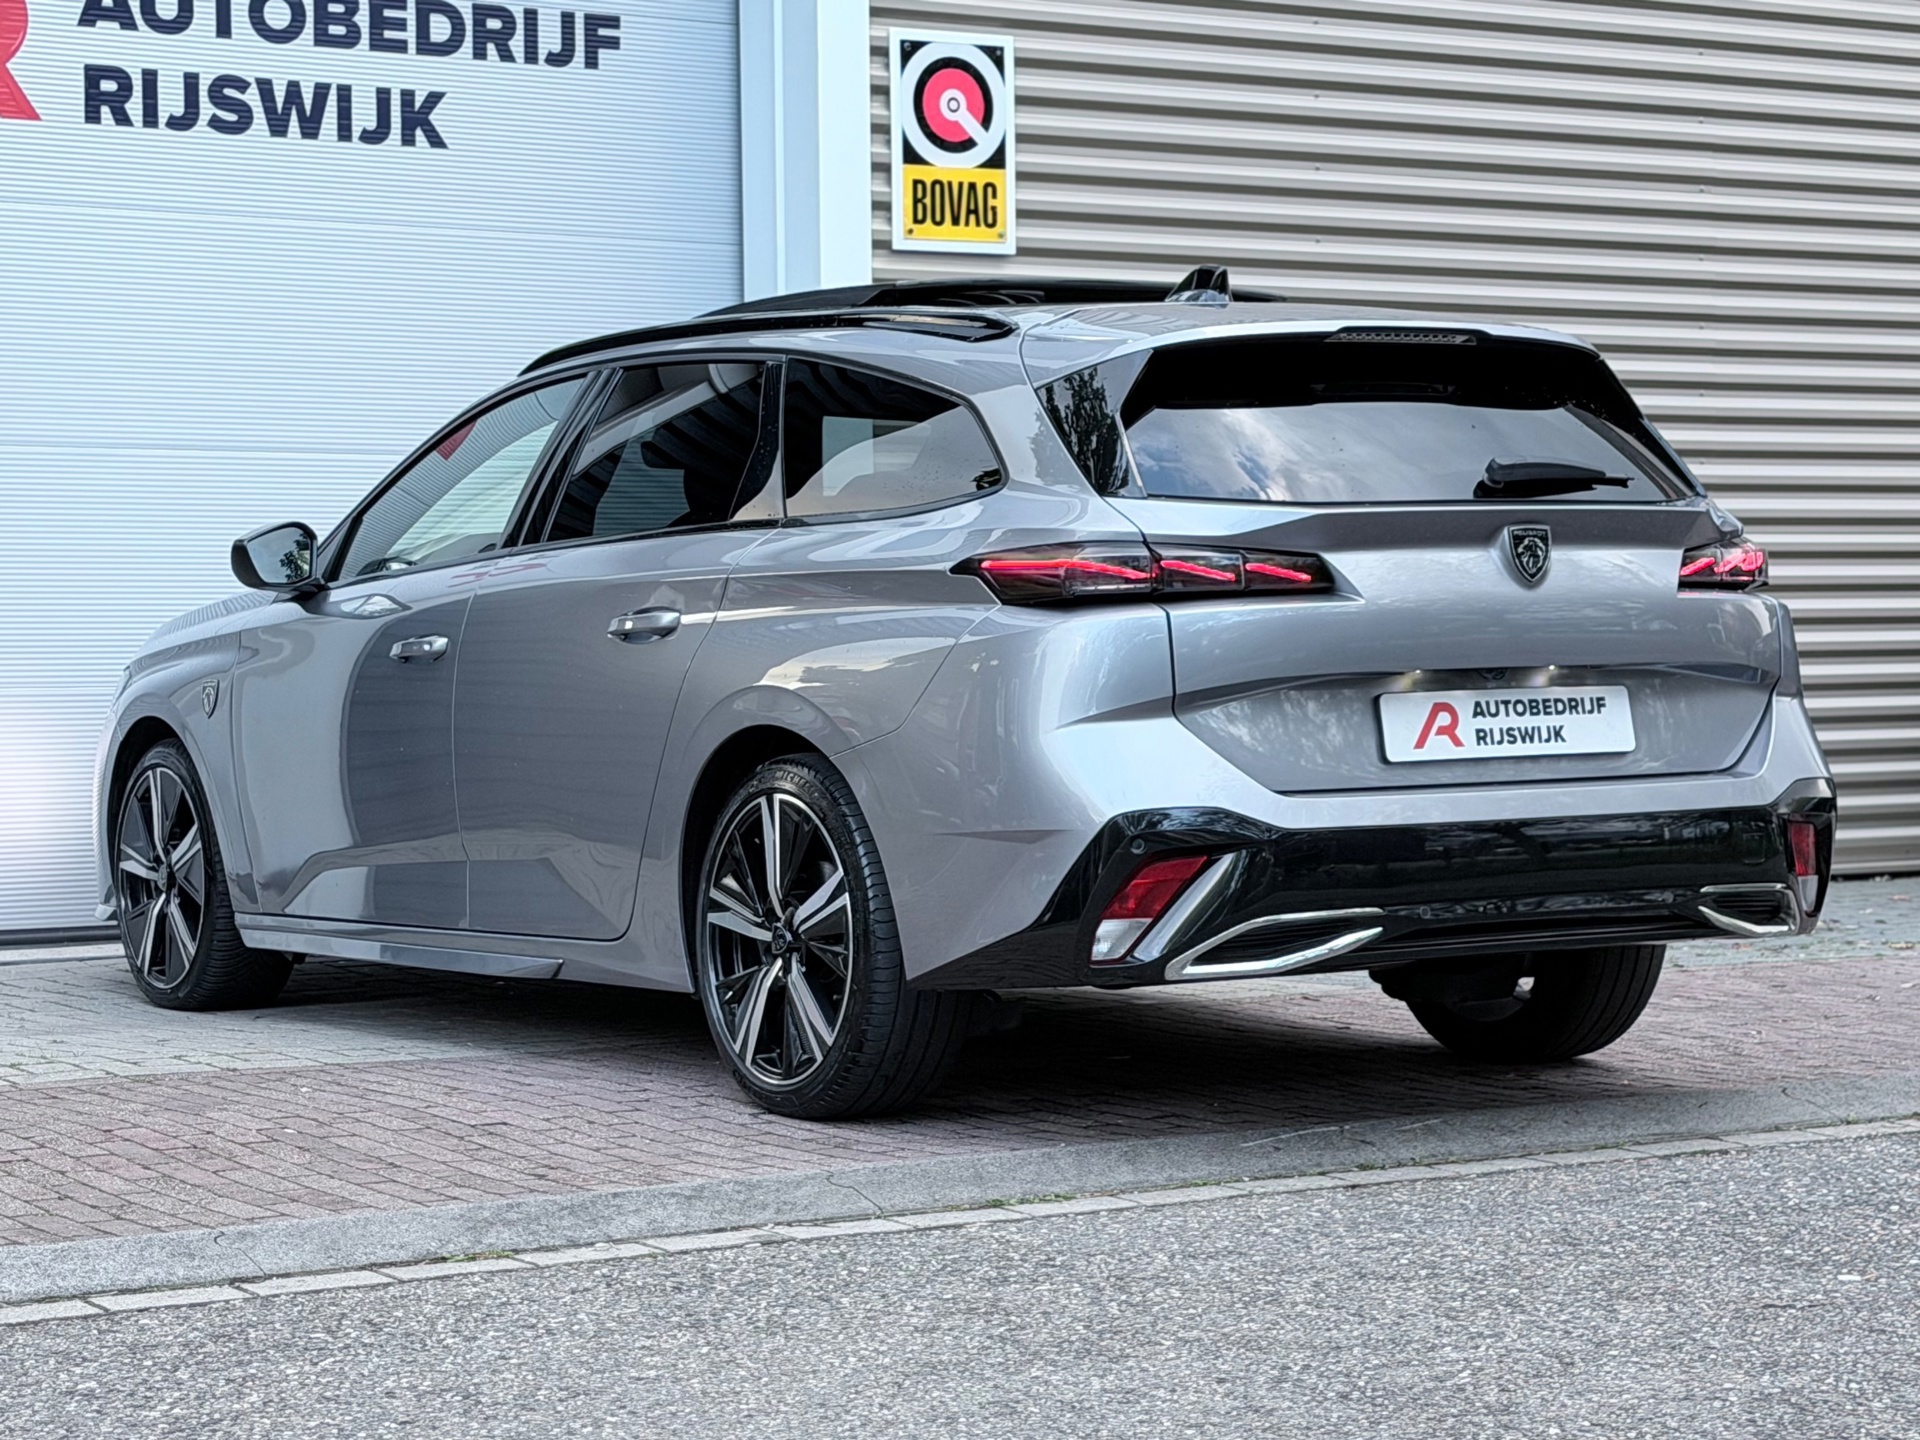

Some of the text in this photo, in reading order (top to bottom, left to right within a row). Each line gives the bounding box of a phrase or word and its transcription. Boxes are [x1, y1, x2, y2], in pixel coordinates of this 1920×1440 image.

[83, 63, 449, 149] RIJSWIJK
[912, 178, 998, 229] BOVAG
[1471, 696, 1607, 719] AUTOBEDRIJF
[1475, 725, 1567, 747] RIJSWIJK
